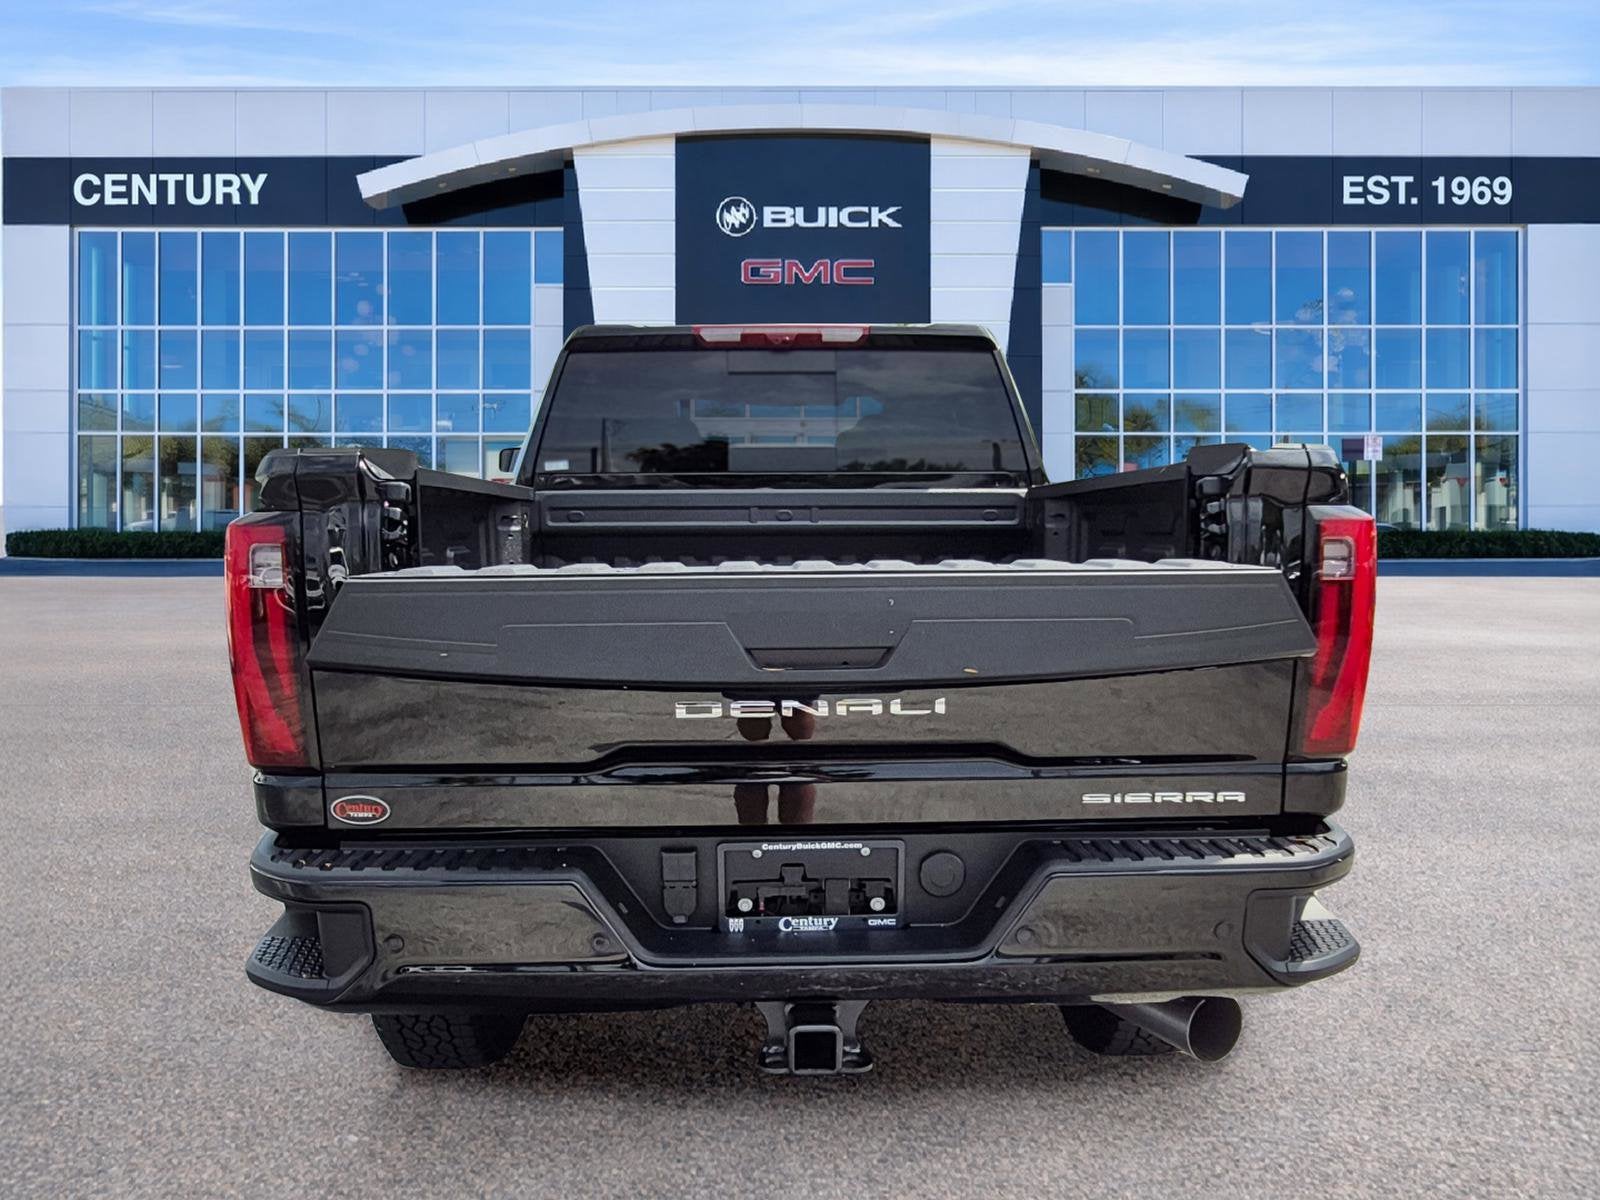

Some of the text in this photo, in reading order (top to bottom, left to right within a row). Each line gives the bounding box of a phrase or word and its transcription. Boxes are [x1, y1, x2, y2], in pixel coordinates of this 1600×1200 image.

[73, 173, 268, 206] CENTURY
[1343, 175, 1513, 206] EST. 1969
[763, 206, 903, 228] BUICK
[741, 258, 875, 285] GMC
[675, 698, 946, 719] DENALI
[1082, 791, 1246, 804] SIERRA
[778, 916, 839, 931] Century
[868, 918, 896, 926] GMC
